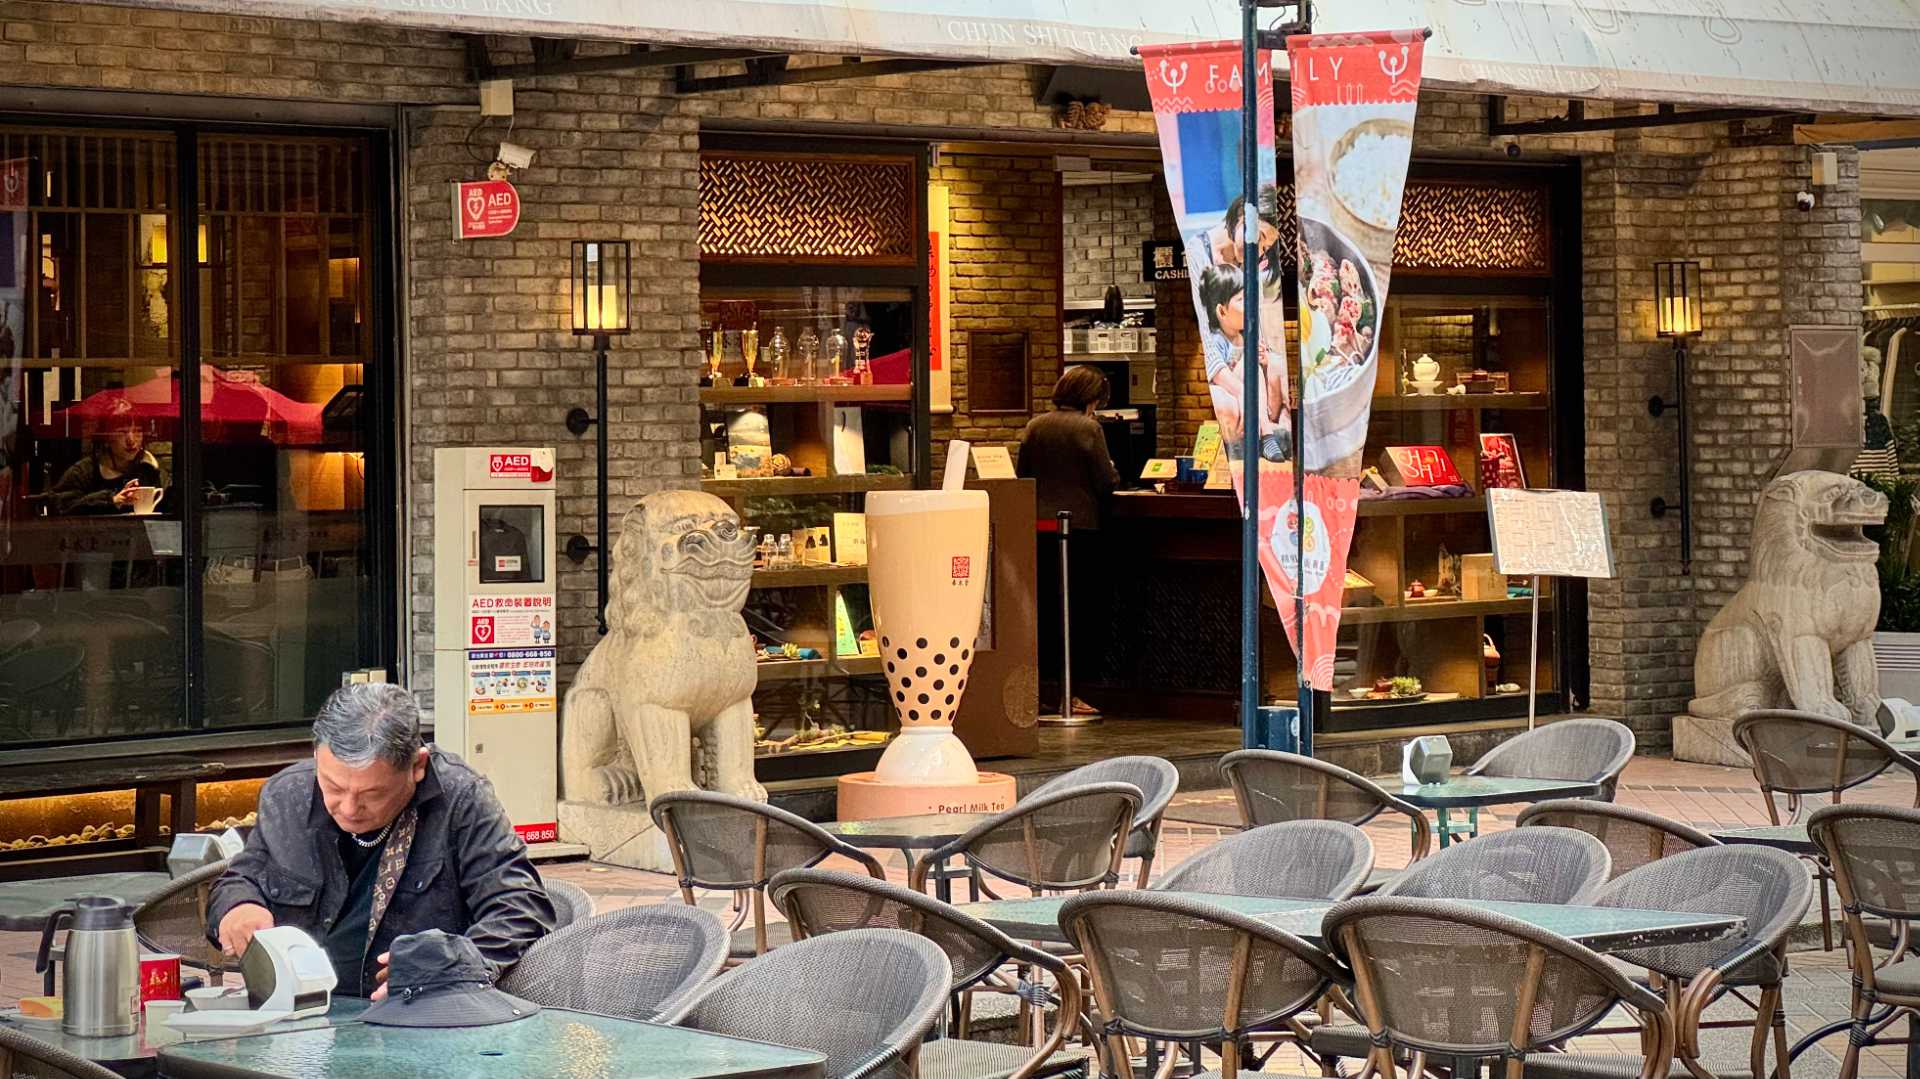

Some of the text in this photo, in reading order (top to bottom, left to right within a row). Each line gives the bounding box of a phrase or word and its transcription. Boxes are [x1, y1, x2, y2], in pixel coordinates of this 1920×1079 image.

[947, 21, 1017, 42] CHUN
[1084, 31, 1143, 51] TANG
[488, 192, 512, 207] AED
[1153, 246, 1188, 269] 櫃
[504, 456, 529, 466] AED
[938, 803, 967, 814] Pearl
[970, 802, 989, 813] Milk
[541, 830, 555, 840] 850
